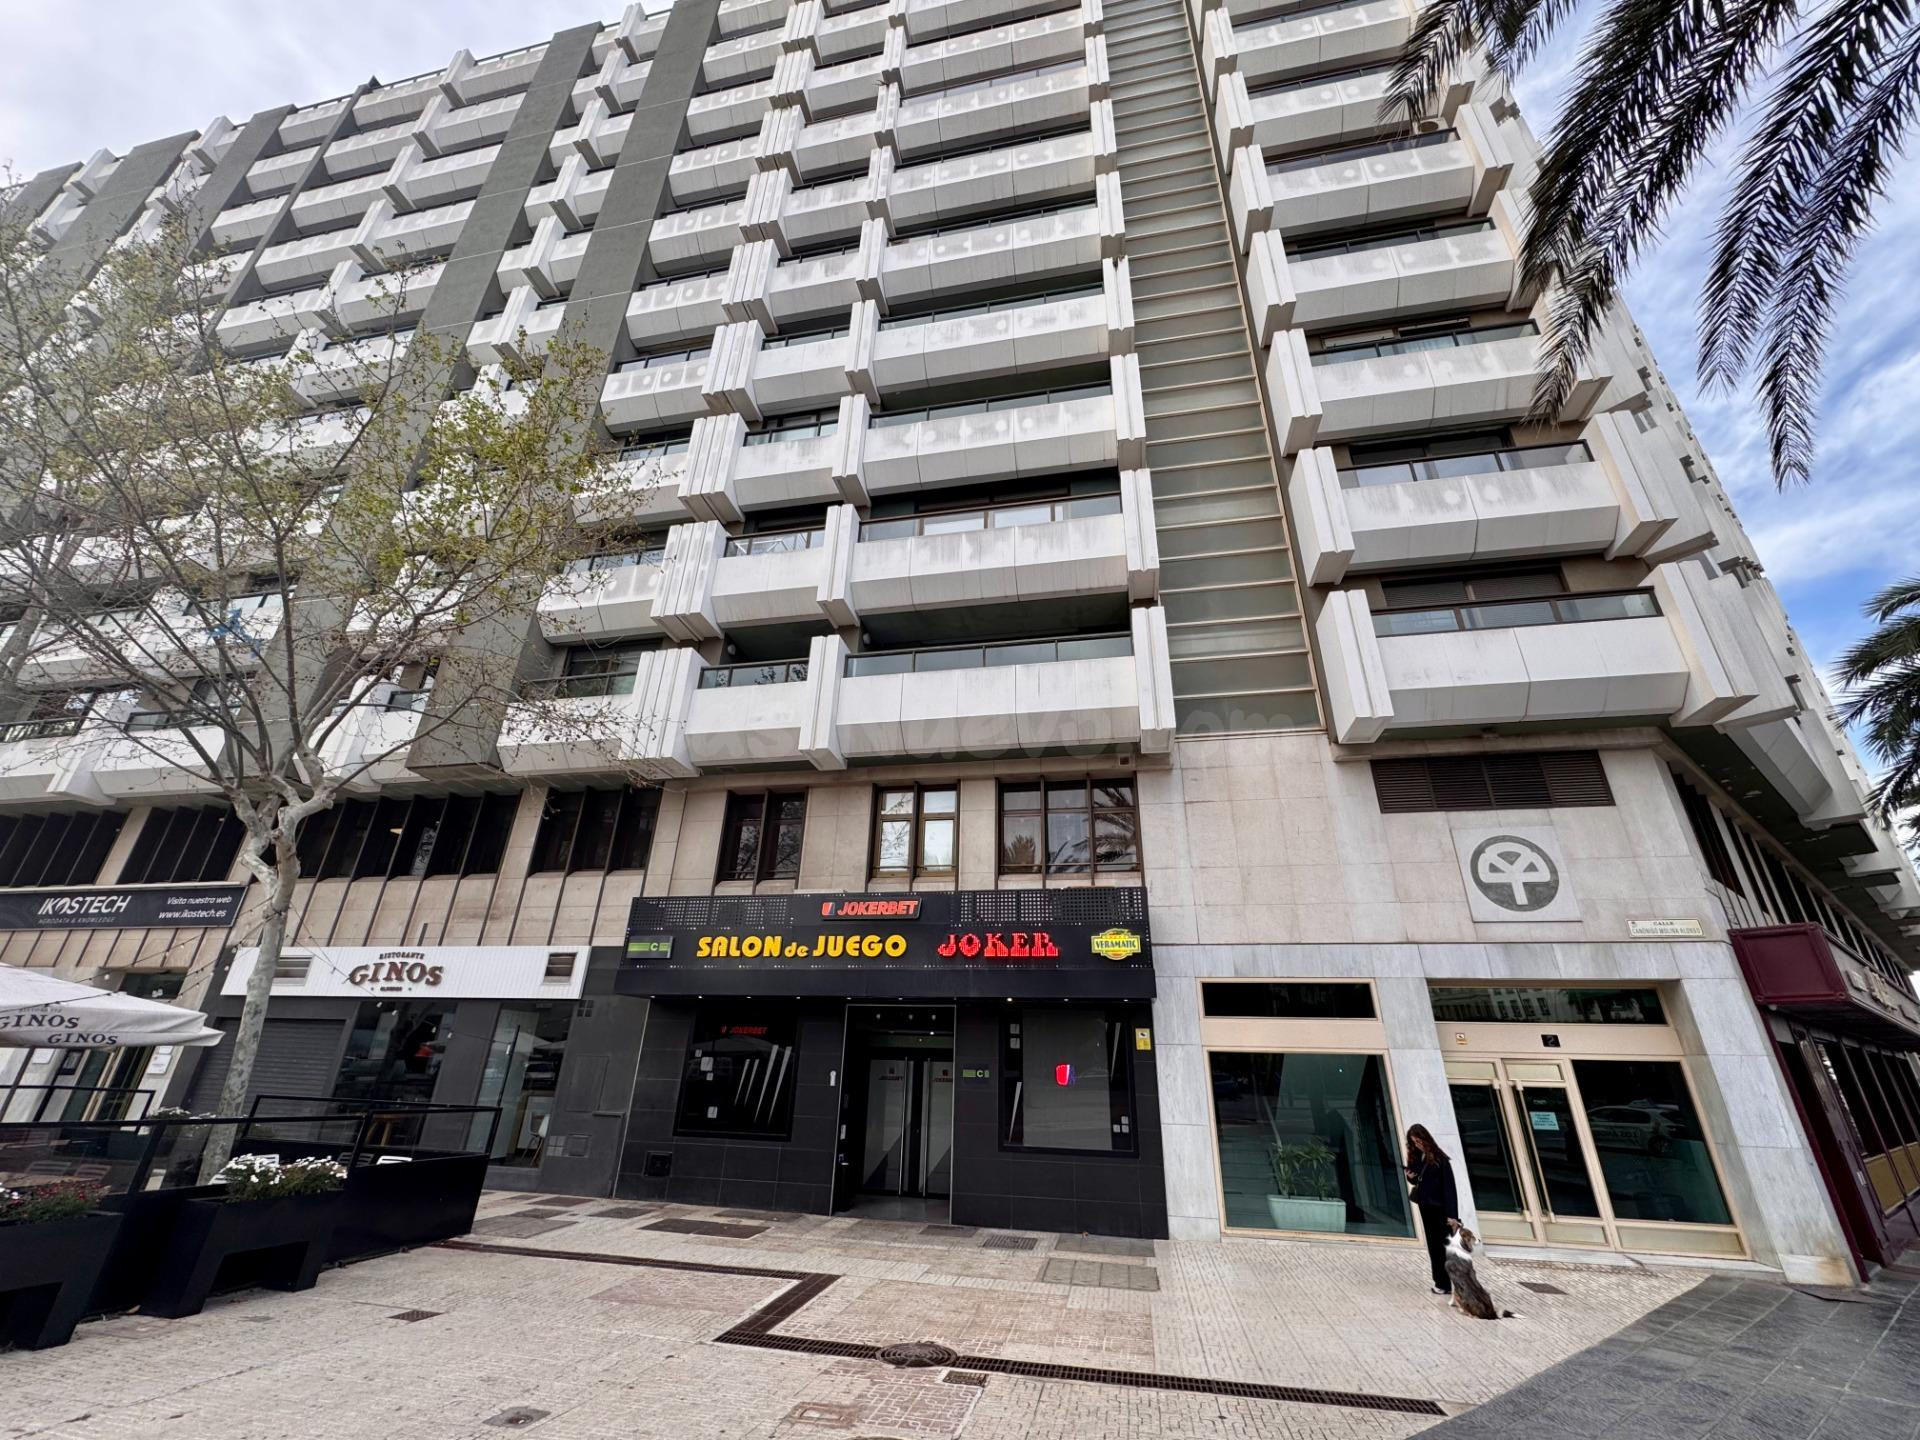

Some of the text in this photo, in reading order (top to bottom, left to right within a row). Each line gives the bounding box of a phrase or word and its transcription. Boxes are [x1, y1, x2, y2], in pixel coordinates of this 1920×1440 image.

[37, 895, 132, 916] IKOSTECH
[837, 900, 919, 916] JOKERBET
[158, 909, 227, 919] www.ikostech.es
[696, 934, 908, 957] SALON de JUEGO
[937, 932, 1059, 957] JOKER
[1095, 939, 1137, 949] VERAMATIC
[379, 951, 425, 960] RISTORANTE
[349, 962, 444, 986] GINOS
[47, 1033, 118, 1045] GINOS
